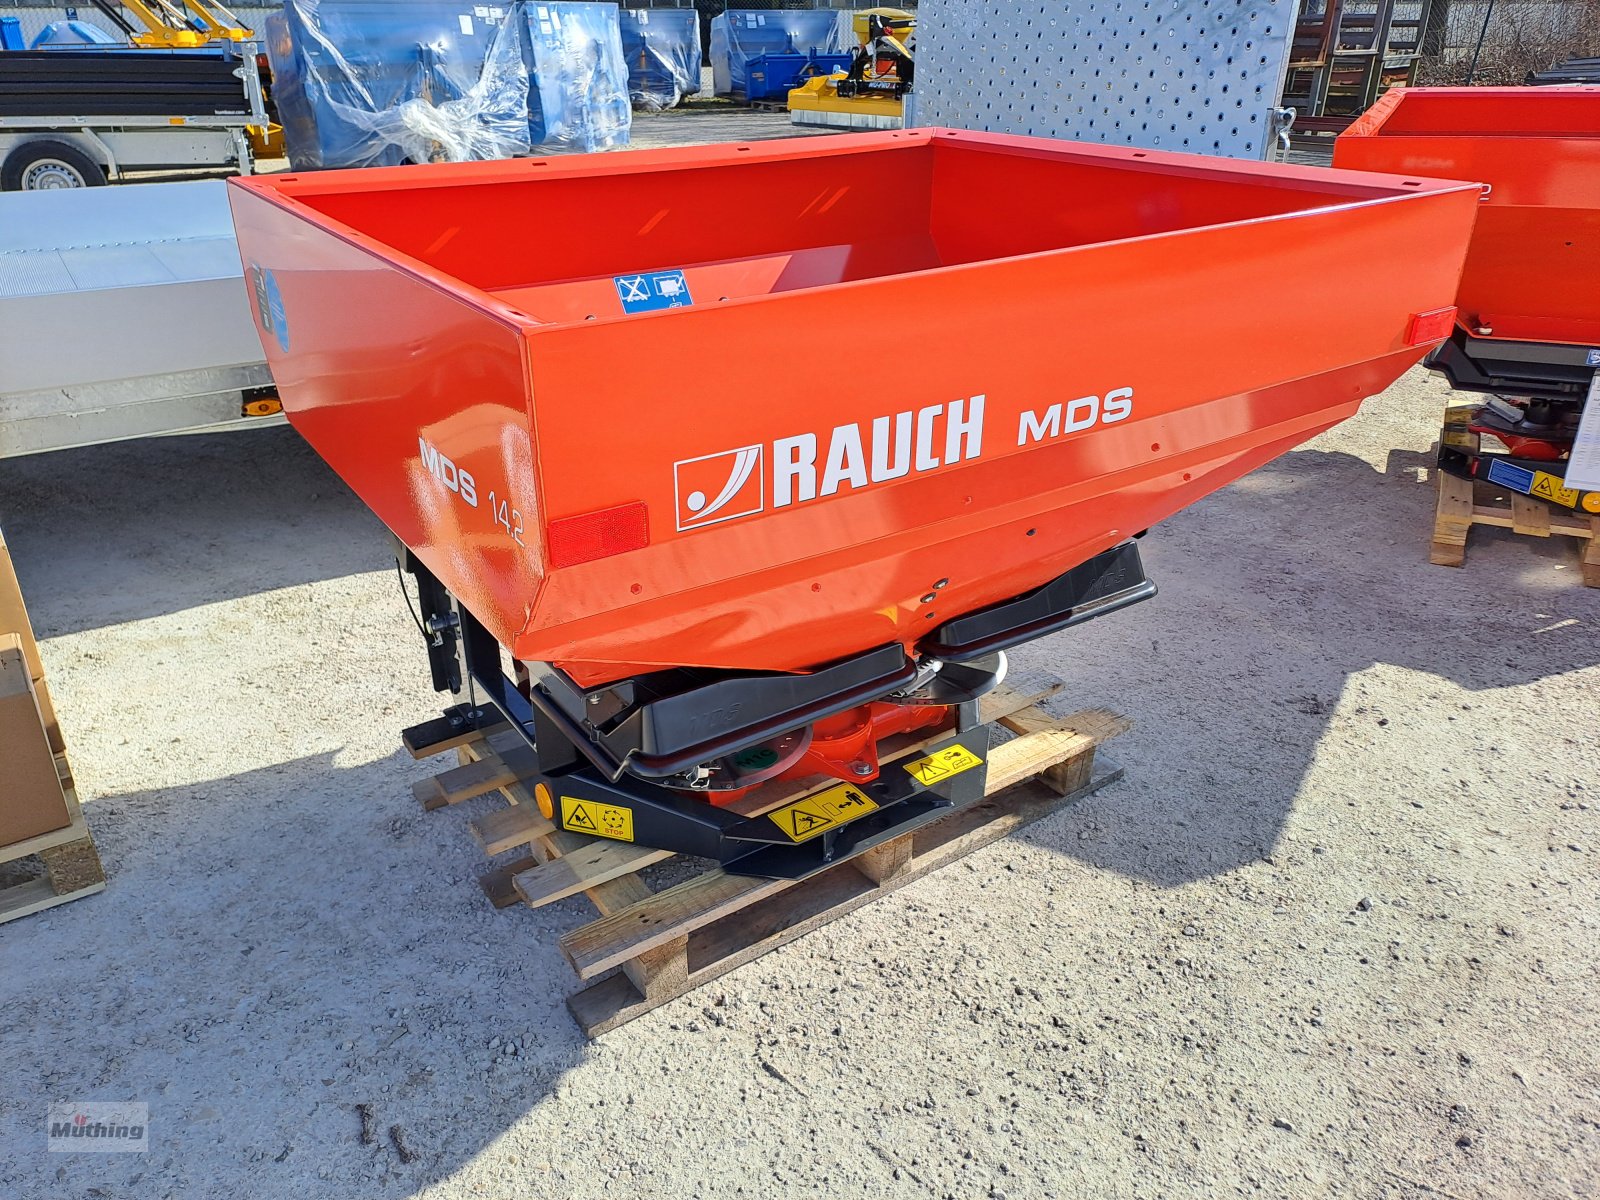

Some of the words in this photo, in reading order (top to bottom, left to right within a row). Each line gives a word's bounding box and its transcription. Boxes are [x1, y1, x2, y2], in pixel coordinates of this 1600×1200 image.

[773, 394, 986, 508] RAUCH
[1017, 386, 1134, 447] MDS
[418, 436, 478, 508] MDS
[488, 491, 525, 548] 14.2
[1087, 567, 1126, 594] MDS
[688, 702, 742, 737] MDS
[604, 827, 624, 836] STOP
